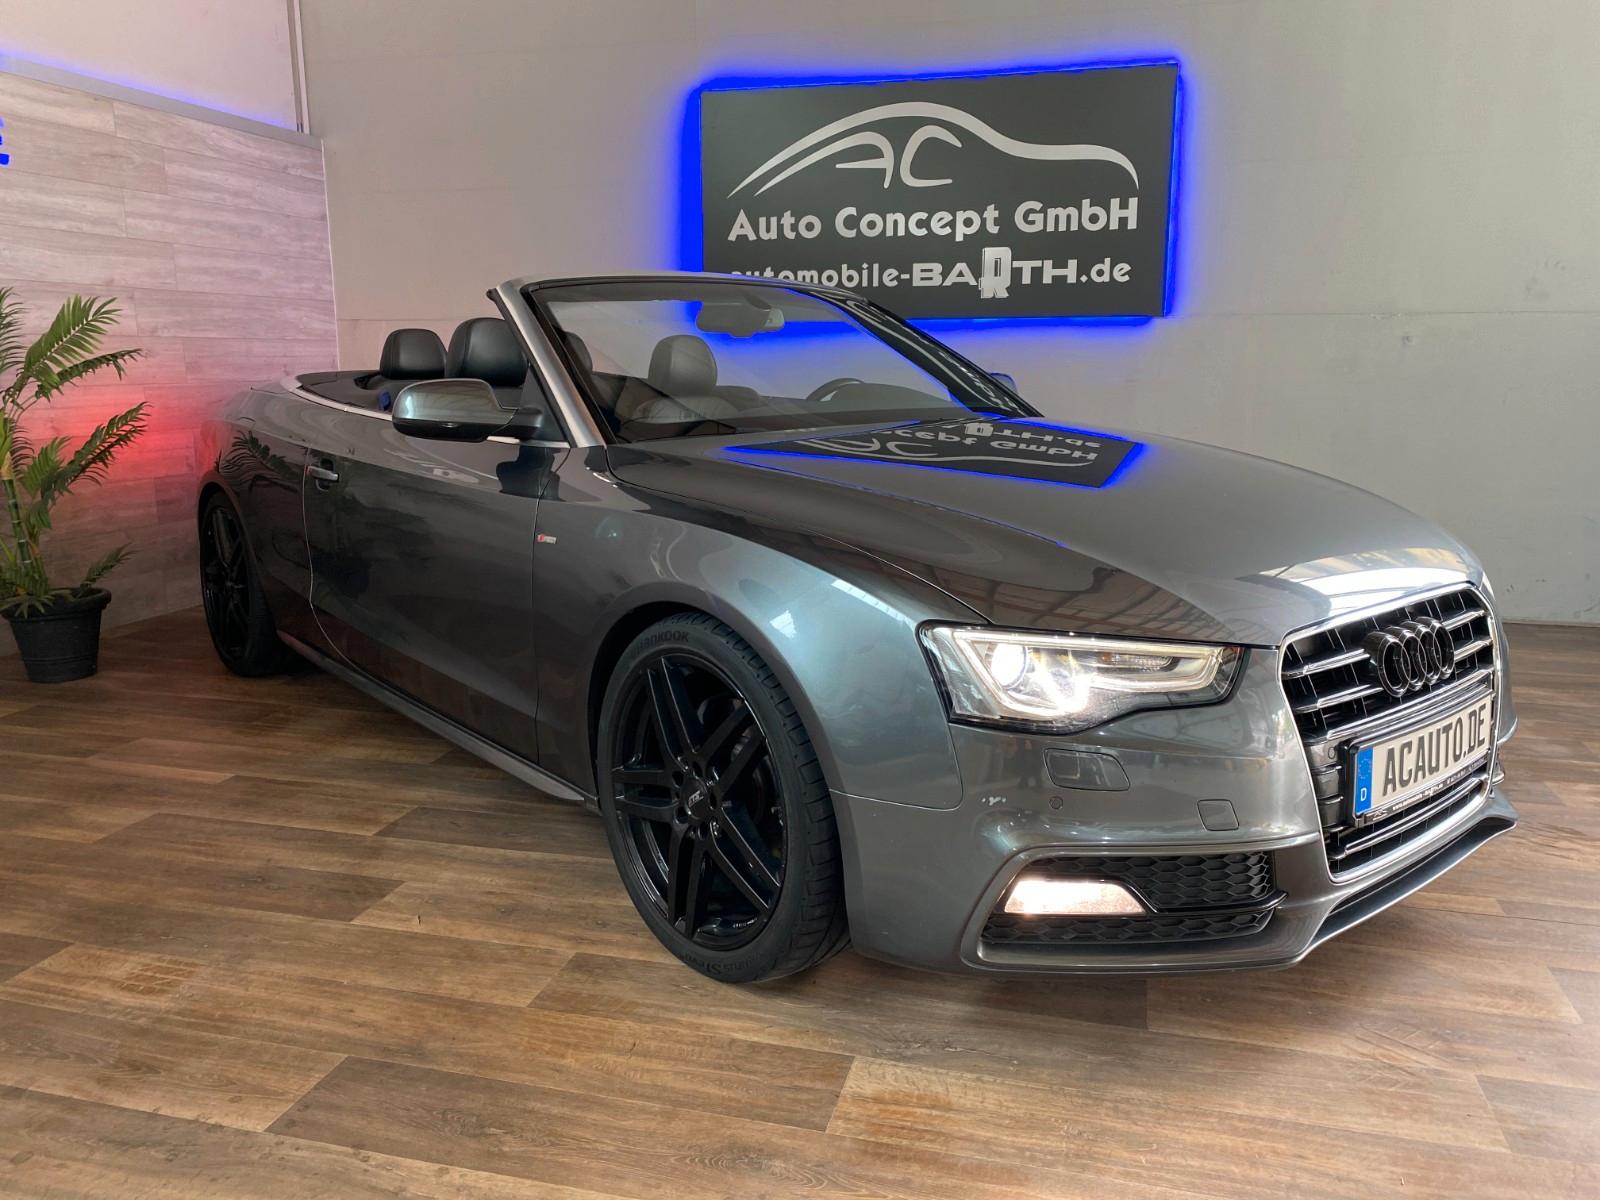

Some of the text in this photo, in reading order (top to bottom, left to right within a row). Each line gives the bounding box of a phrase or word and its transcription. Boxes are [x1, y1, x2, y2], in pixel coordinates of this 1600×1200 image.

[727, 197, 1139, 241] Auto Concept GmbH
[731, 247, 1132, 298] tomobile-BARTH.de
[1382, 703, 1486, 796] ACAUTO.DE
[1360, 787, 1367, 802] D
